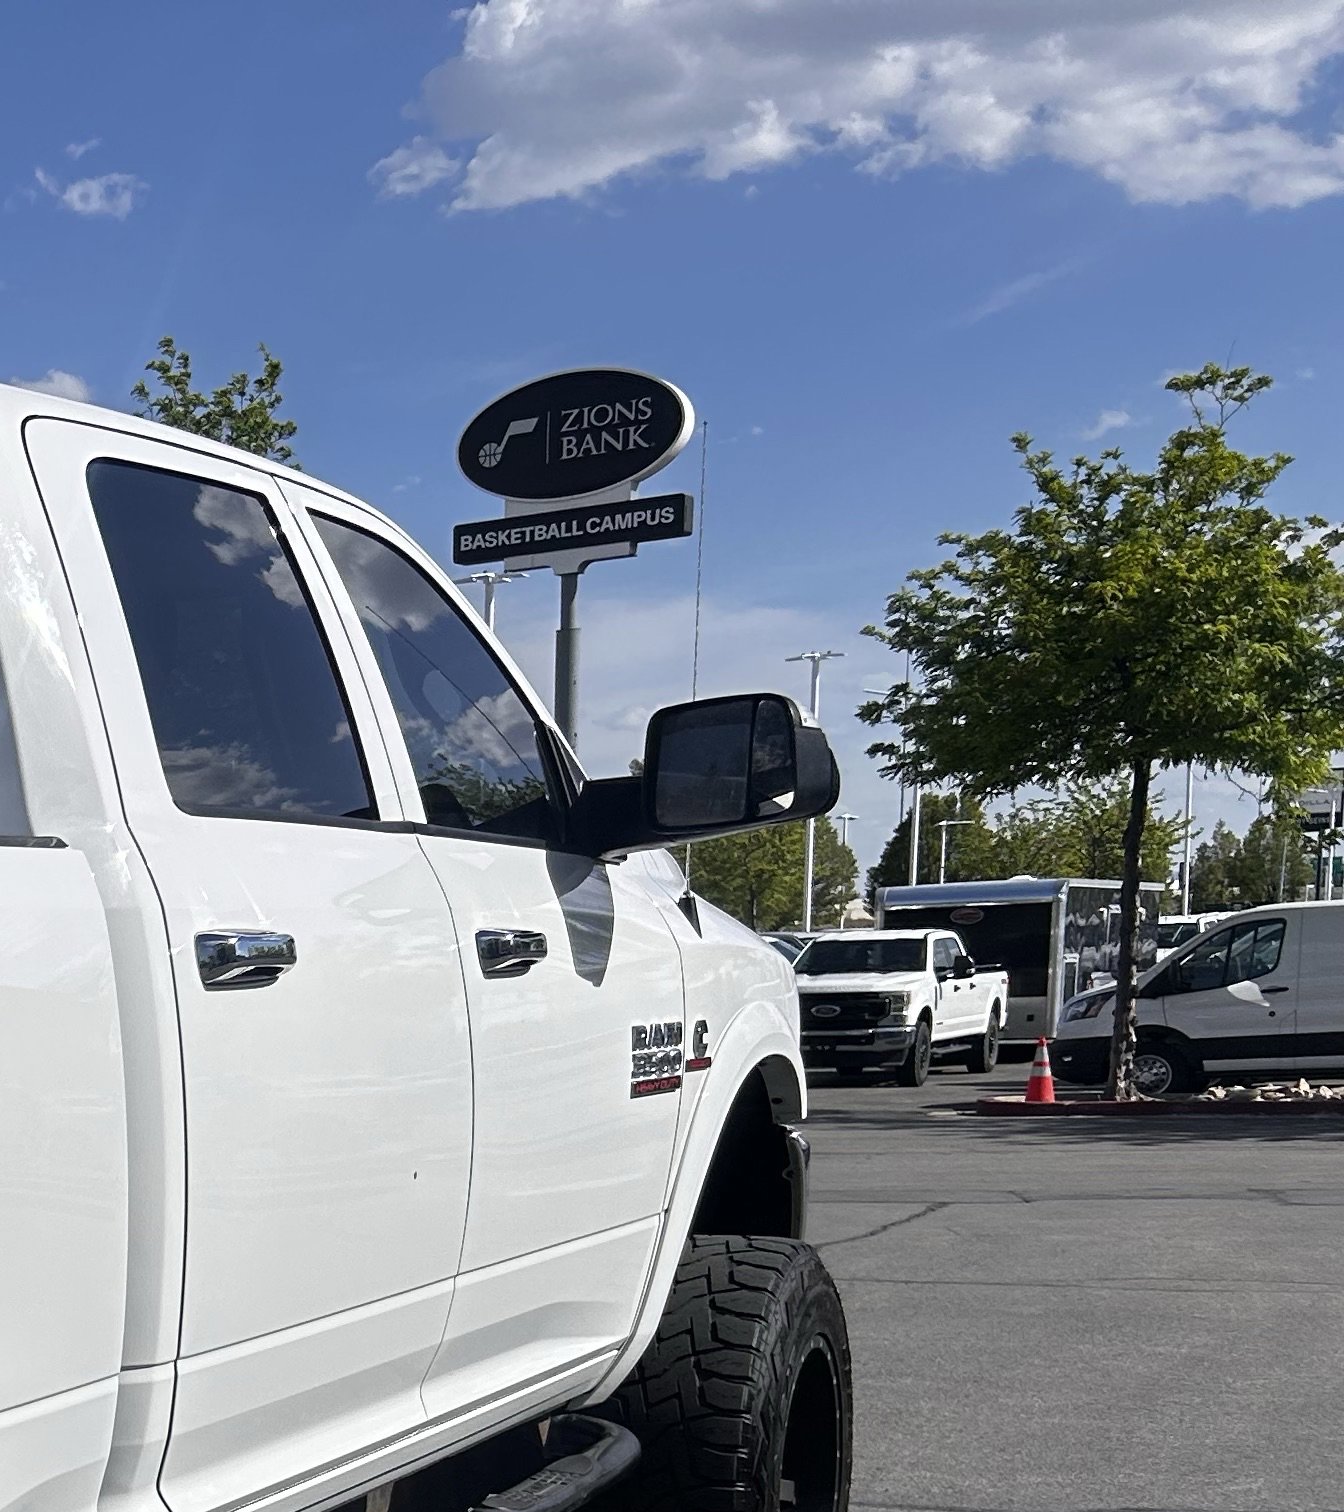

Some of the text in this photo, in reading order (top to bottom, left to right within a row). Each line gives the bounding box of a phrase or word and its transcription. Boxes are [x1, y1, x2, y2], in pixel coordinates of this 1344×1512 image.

[560, 396, 653, 432] ZIONS
[560, 423, 652, 461] BANK
[460, 506, 675, 551] BASKETBALL CAMPUS
[631, 1021, 682, 1052] RAM
